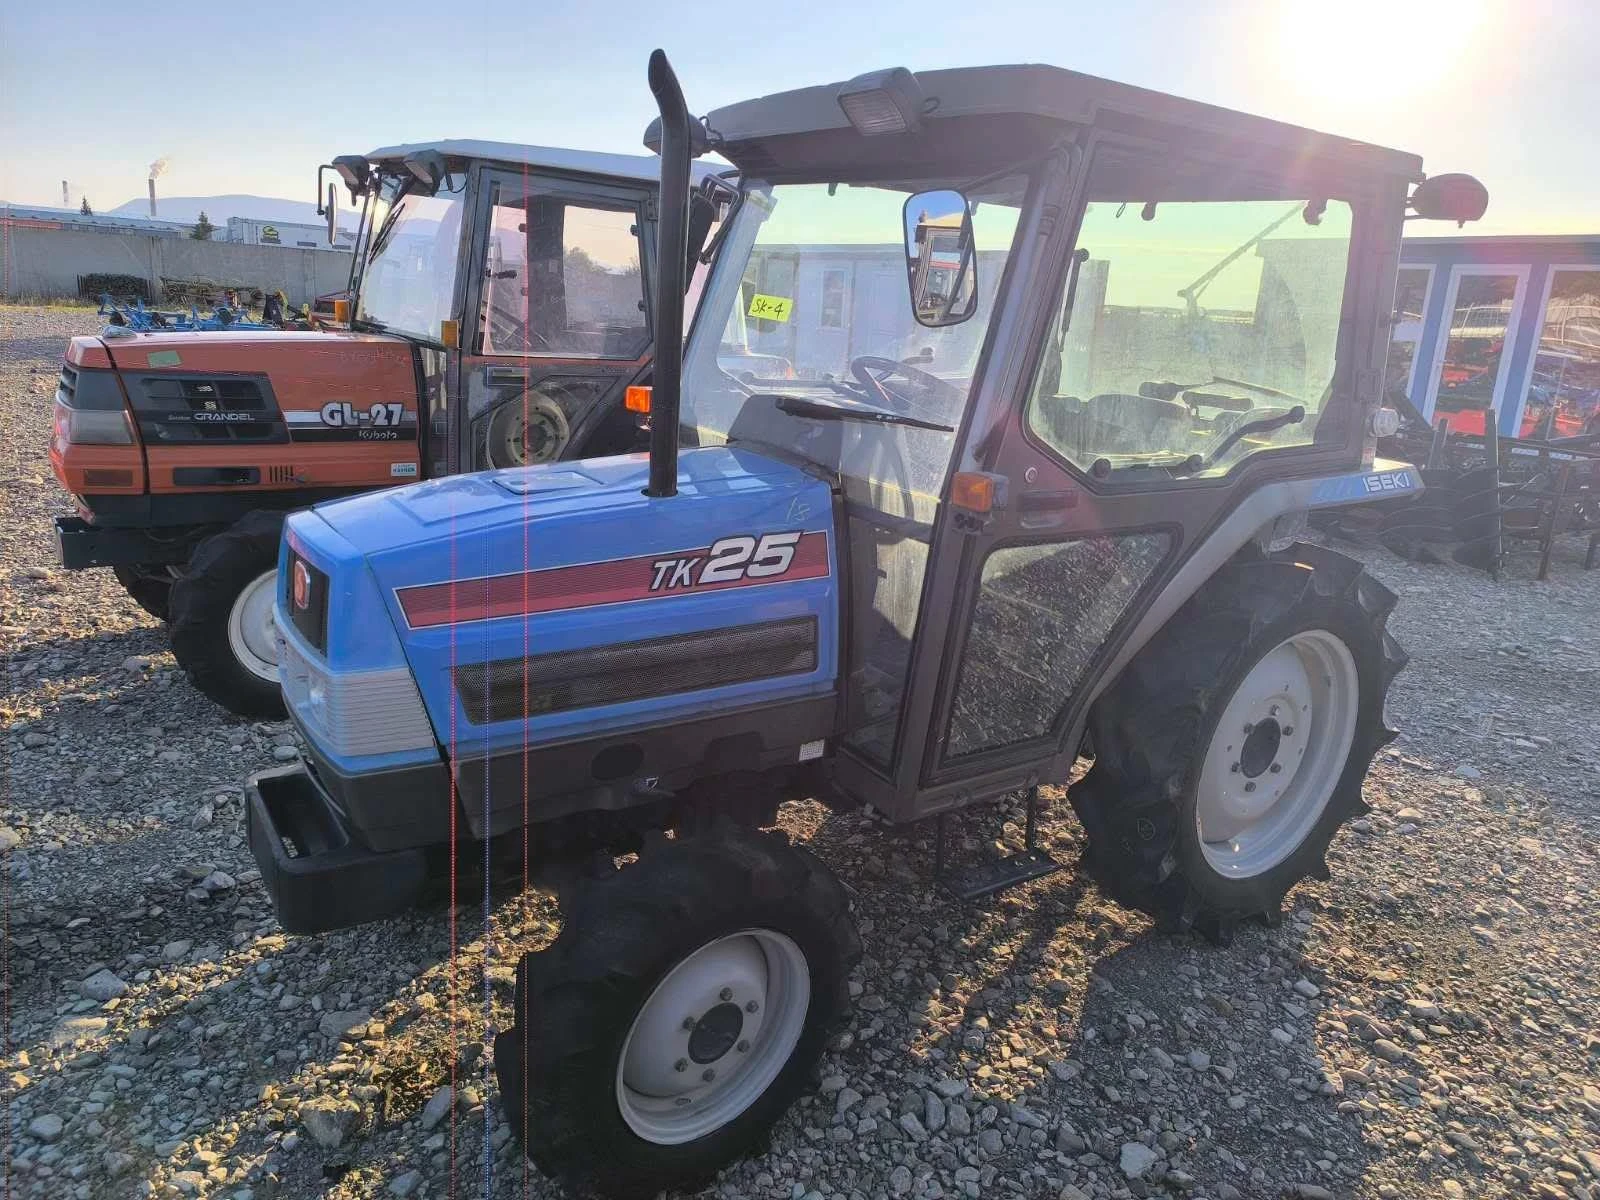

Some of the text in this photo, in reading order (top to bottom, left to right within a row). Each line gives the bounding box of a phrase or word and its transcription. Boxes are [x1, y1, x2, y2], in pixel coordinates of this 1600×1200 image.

[194, 412, 256, 421] GRANDEL
[320, 401, 404, 428] GL-27
[358, 430, 398, 440] Kubota
[1362, 471, 1411, 493] ISEKI
